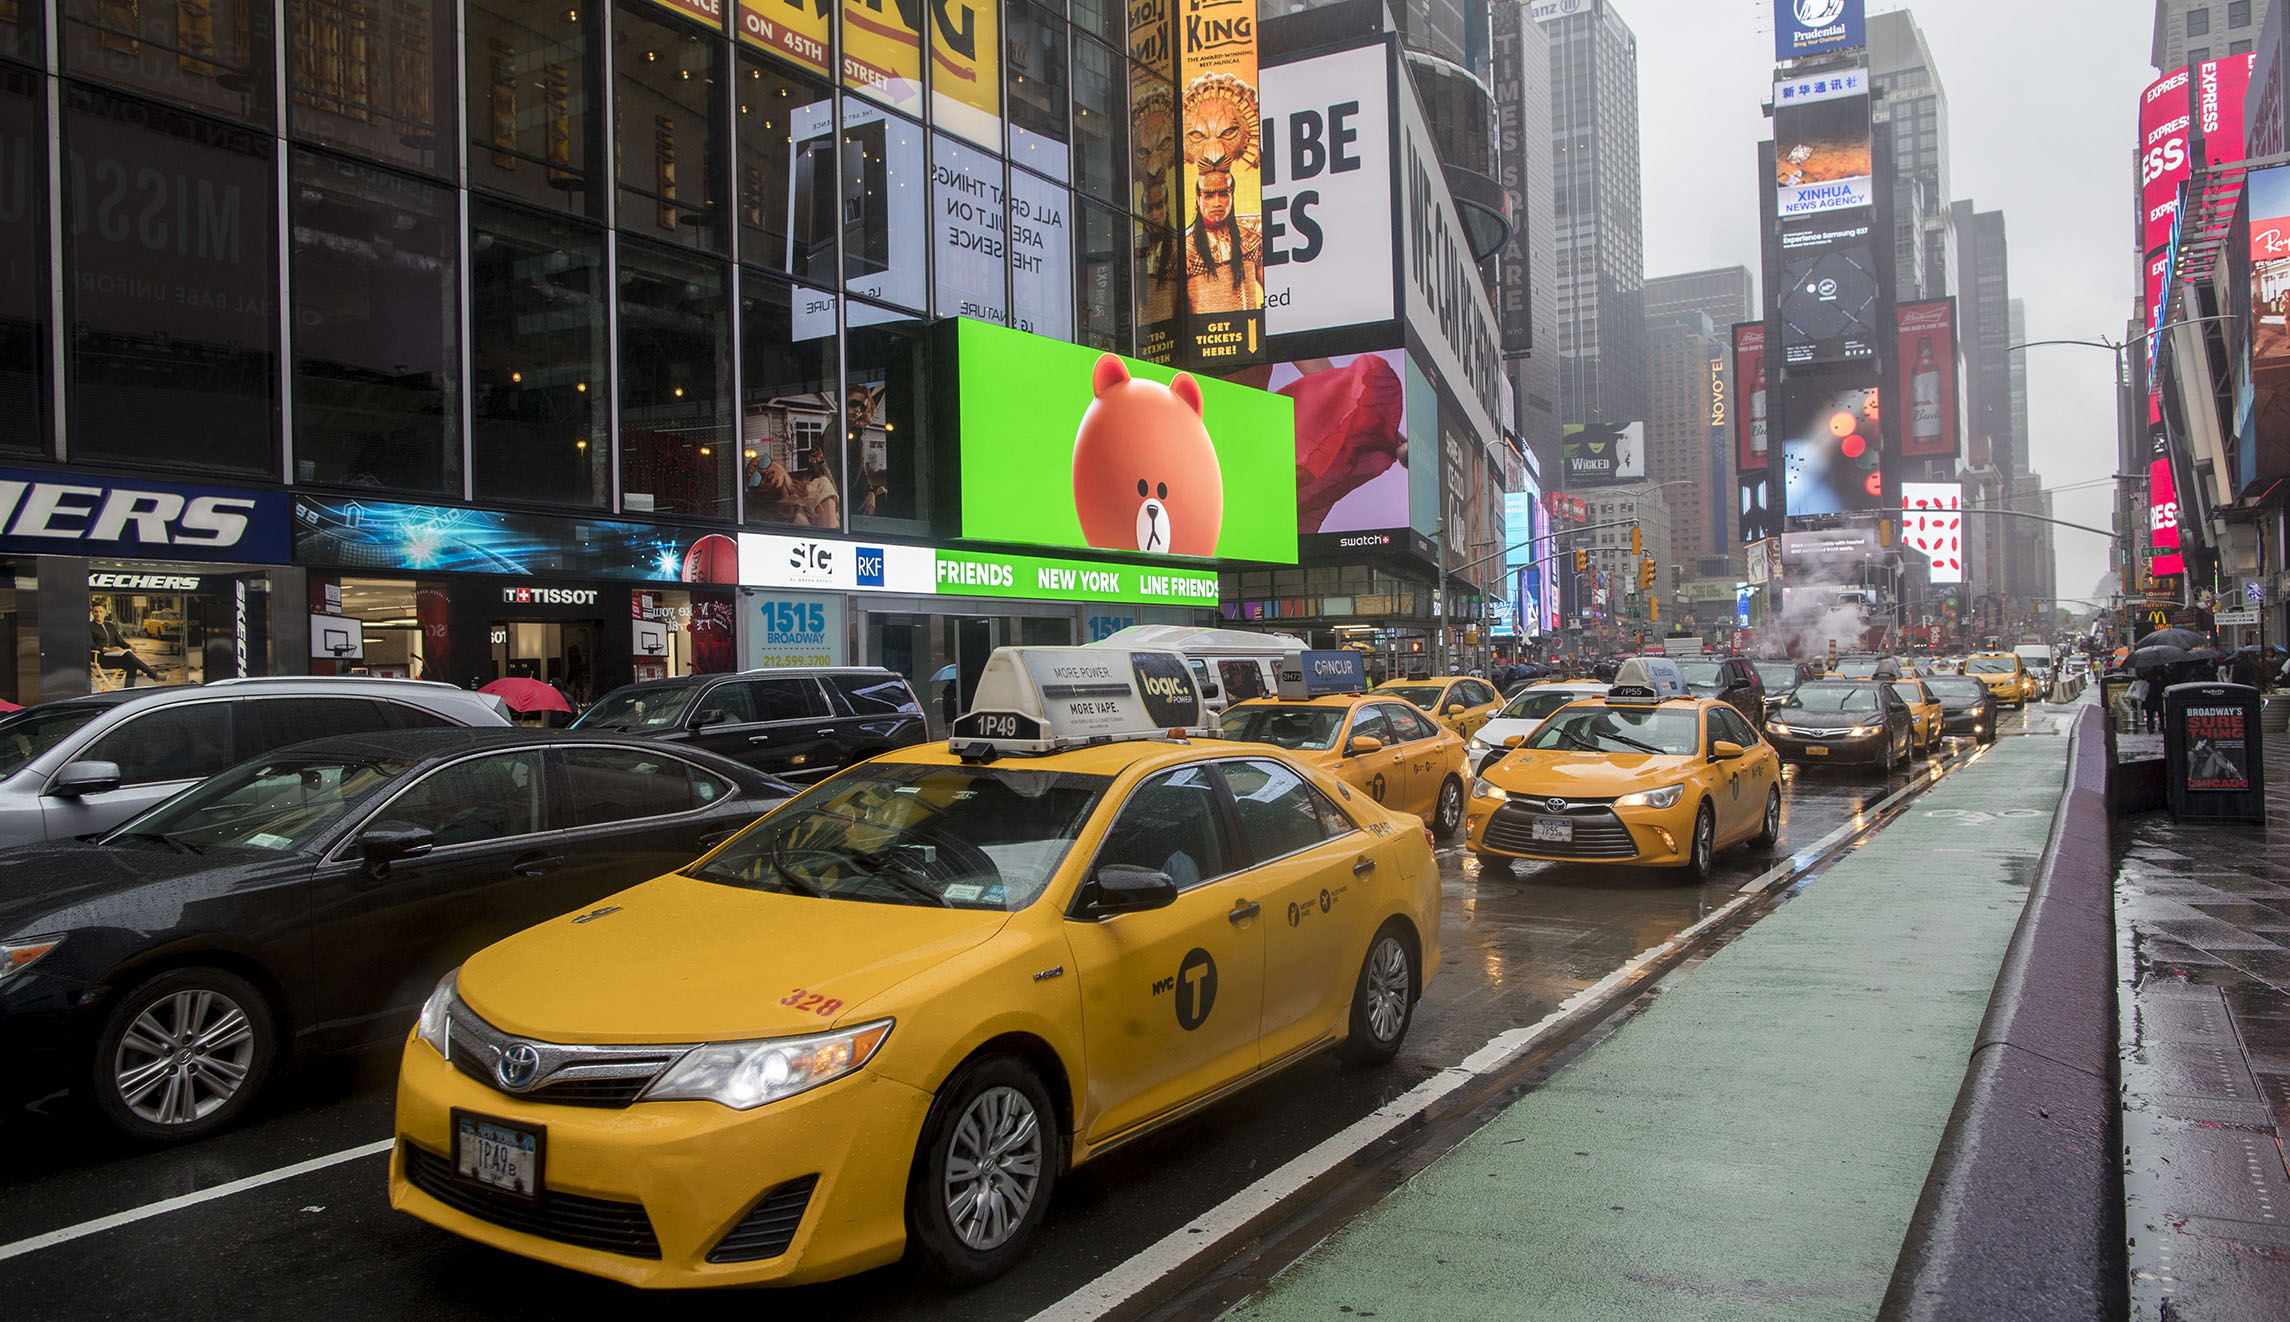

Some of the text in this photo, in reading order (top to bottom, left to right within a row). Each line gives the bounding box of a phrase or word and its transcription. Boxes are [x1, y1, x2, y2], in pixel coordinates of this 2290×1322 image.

[1186, 14, 1252, 53] KING
[1793, 24, 1846, 41] Prudential
[746, 14, 773, 39] ON
[783, 32, 822, 62] 45TH
[844, 59, 888, 91] STREET
[1782, 76, 1858, 99] 新华通讯社
[2202, 62, 2218, 133] EXPRESS
[1290, 100, 1361, 182] BE
[1496, 33, 1523, 311] TIMES SQUARE
[1798, 185, 1852, 202] XINHUA
[1786, 194, 1865, 212] NEWS AGENCY
[1405, 124, 1434, 315] WE
[1783, 233, 1821, 244] Experience
[1822, 229, 1855, 240] Samsung
[1856, 227, 1868, 235] 837
[1208, 322, 1230, 333] GET
[1196, 332, 1243, 345] TICKETS
[1202, 345, 1237, 357] HERE!
[1711, 352, 1725, 426] NOVOTEL
[1340, 535, 1382, 546] swatch
[858, 556, 882, 577] RKF
[937, 559, 1013, 587] FRIENDS
[1038, 567, 1077, 590] NEW
[1079, 570, 1120, 593] YORK
[1140, 575, 1169, 596] LINE
[531, 588, 597, 605] TISSOT
[761, 601, 825, 633] 1515
[767, 632, 825, 644] BROADWAY
[1931, 626, 1939, 643] tkts
[764, 655, 831, 667] 212.599.3700
[1054, 666, 1113, 679] MORE POWER.
[1283, 672, 1302, 681] 2H73
[1140, 669, 1188, 703] logic.
[1620, 687, 1643, 696] 7P55
[1070, 701, 1120, 715] MORE VAPE.
[1173, 695, 1193, 704] POWER
[2187, 707, 2243, 717] BROADWAY'S
[977, 716, 1017, 737] 1P49
[2188, 716, 2244, 728] SURE
[2188, 728, 2244, 739] THING
[2188, 779, 2248, 788] CHICAGO
[1152, 976, 1174, 997] NYC
[780, 988, 843, 1016] 328
